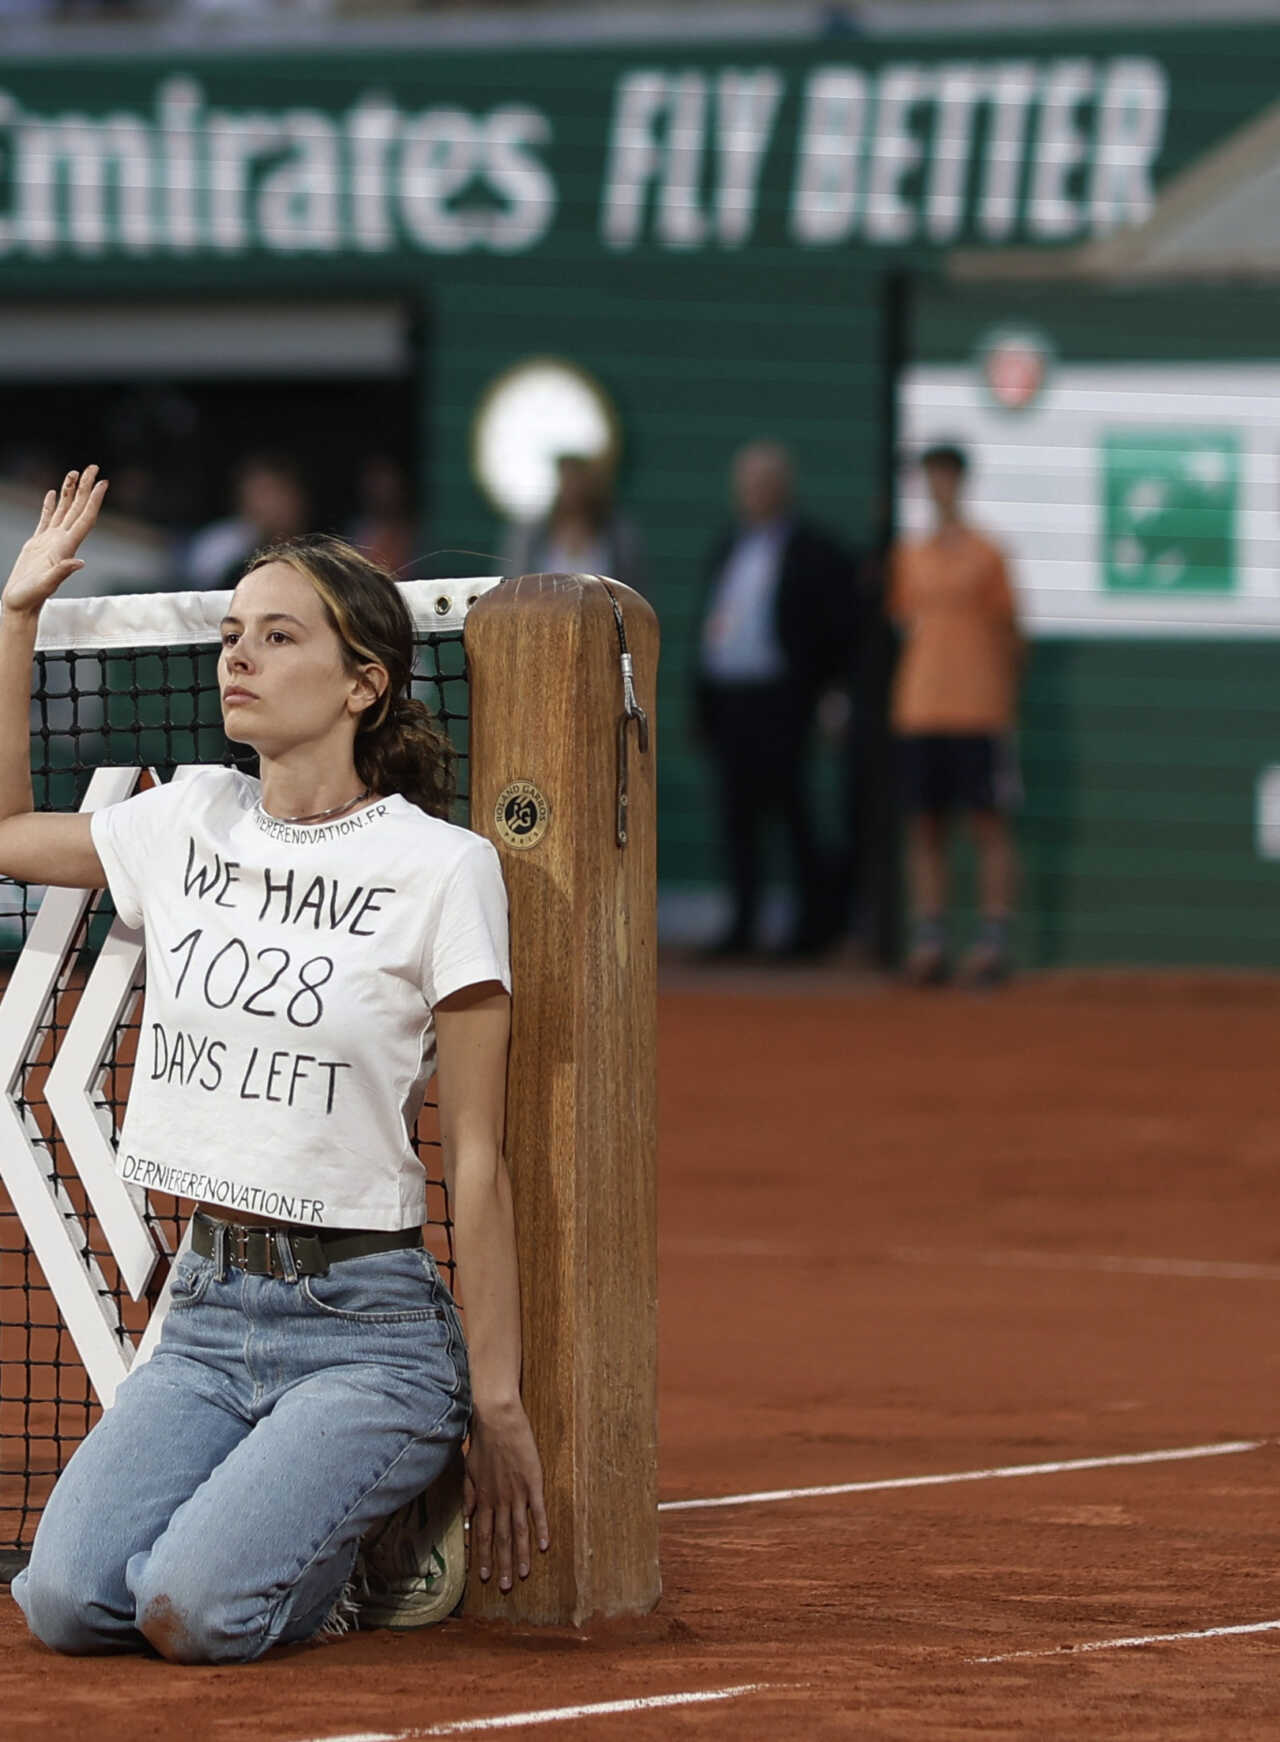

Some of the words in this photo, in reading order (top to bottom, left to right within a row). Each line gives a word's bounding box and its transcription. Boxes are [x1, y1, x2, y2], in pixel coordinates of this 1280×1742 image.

[602, 67, 784, 251] FLY
[792, 56, 1167, 244] BETTER
[495, 784, 520, 823] ROLAND
[522, 784, 547, 822] GARROS
[184, 836, 241, 908] WE
[259, 867, 396, 937] HAVE
[170, 928, 334, 1028] 1028
[151, 1022, 227, 1091] DAYS
[240, 1047, 353, 1115] LEFT
[122, 1155, 325, 1223] DERNIERERENOVATION.FR
